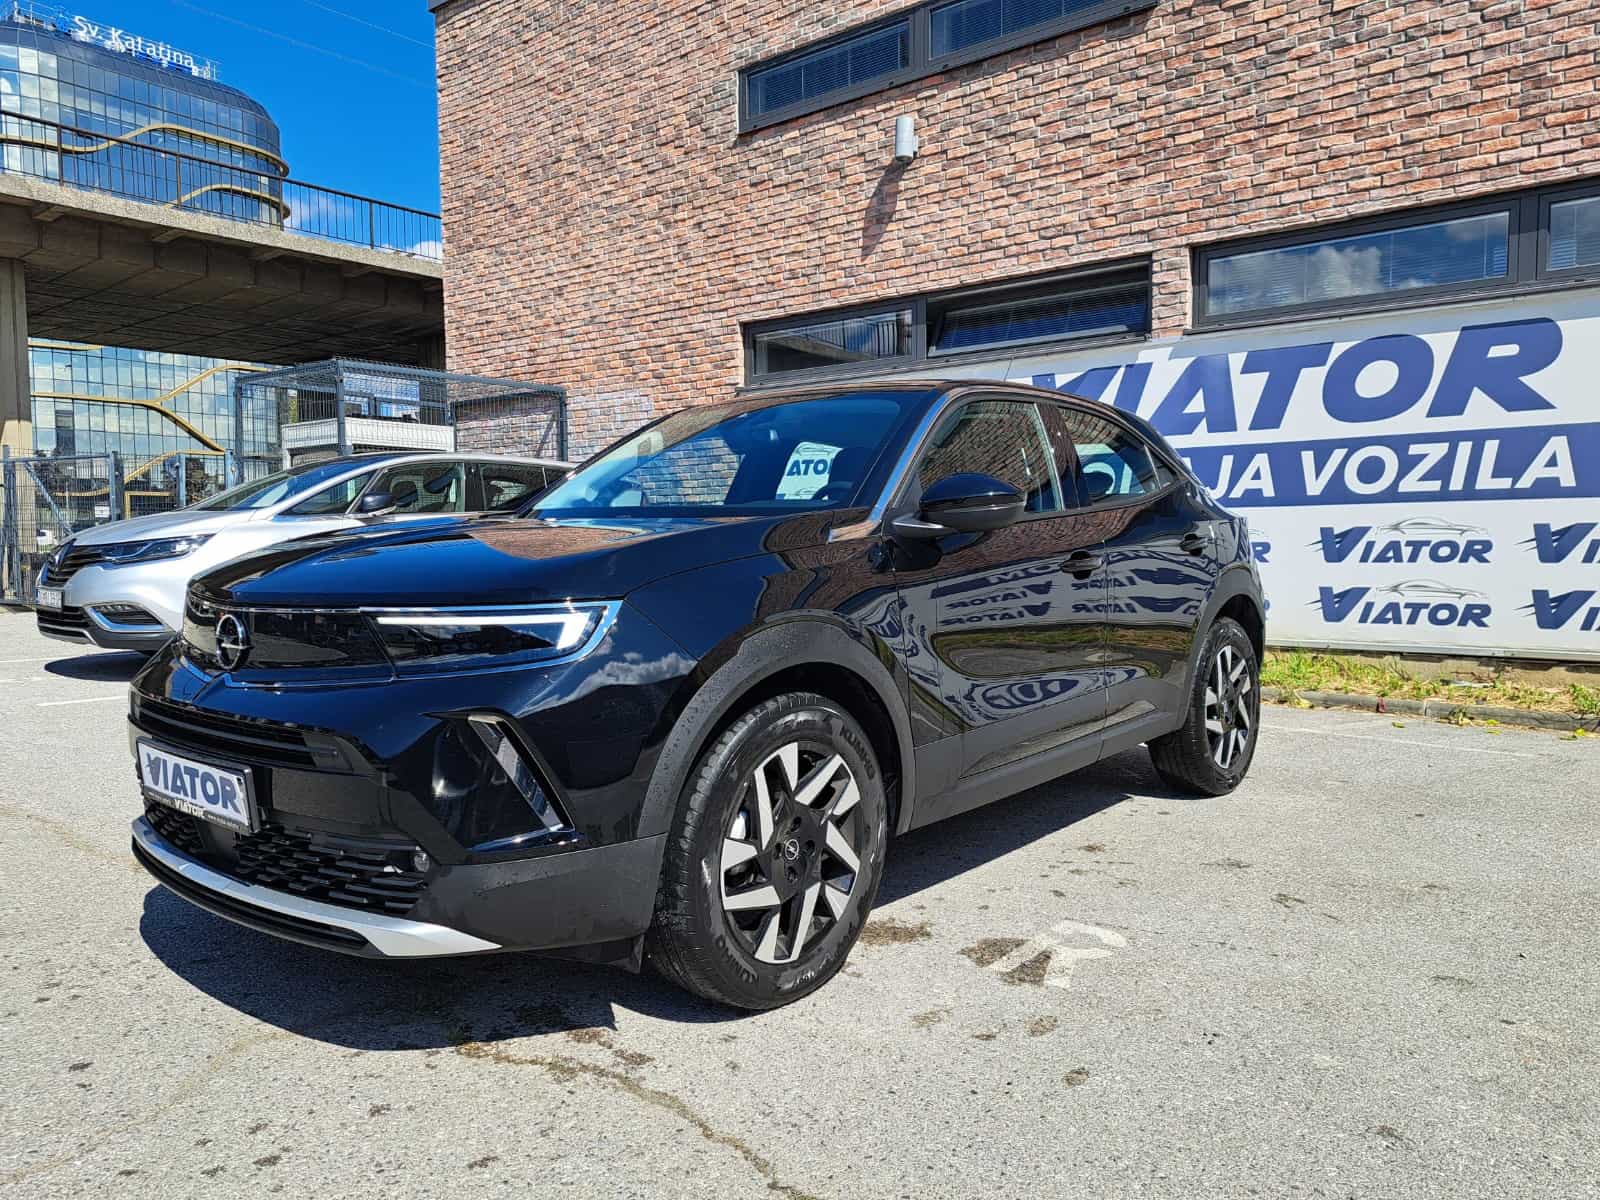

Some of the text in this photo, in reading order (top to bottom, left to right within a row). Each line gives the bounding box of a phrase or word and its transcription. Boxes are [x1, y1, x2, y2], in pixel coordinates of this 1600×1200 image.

[1301, 435, 1577, 496] VOZILA
[1308, 526, 1493, 563] VIATOR
[1307, 586, 1492, 627] VIATOR
[146, 752, 242, 813] VIATOR
